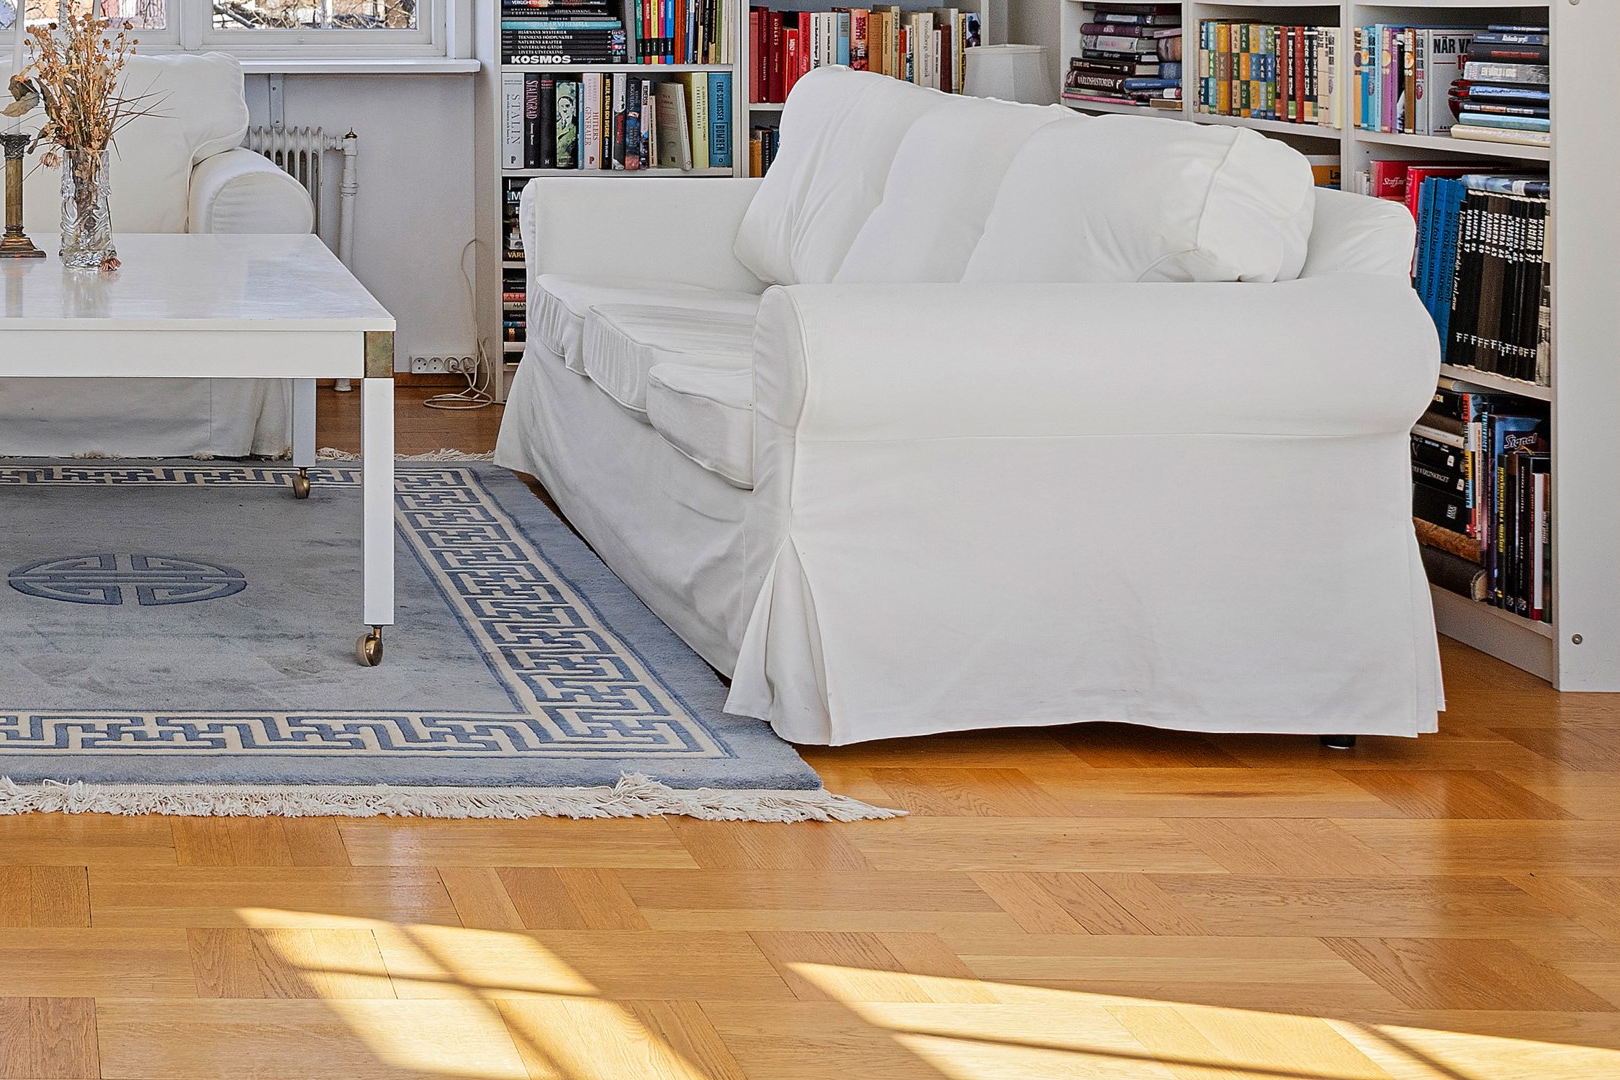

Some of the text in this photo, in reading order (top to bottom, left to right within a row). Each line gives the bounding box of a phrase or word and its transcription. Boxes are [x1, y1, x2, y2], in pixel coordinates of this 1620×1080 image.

[1433, 37, 1455, 53] NÄR
[511, 56, 571, 64] KOSMOS
[716, 82, 724, 92] ERIC
[526, 80, 538, 119] STALINGRAD
[511, 94, 520, 144] STALIN
[584, 107, 592, 145] GENERALER
[715, 125, 725, 151] BOMBEN
[1420, 226, 1428, 246] folk
[1492, 213, 1500, 244] KAMERA
[1499, 214, 1507, 245] KAMERA
[1443, 230, 1451, 248] folk
[1464, 243, 1470, 252] 57
[1418, 248, 1425, 259] på
[1430, 248, 1436, 260] på
[1441, 251, 1447, 262] på
[1448, 252, 1455, 264] på
[1485, 246, 1490, 254] 61
[1536, 254, 1542, 263] 74
[1427, 263, 1436, 299] marsch
[1437, 265, 1446, 302] marsch
[1445, 266, 1453, 303] marsch
[1504, 433, 1538, 449] Signal
